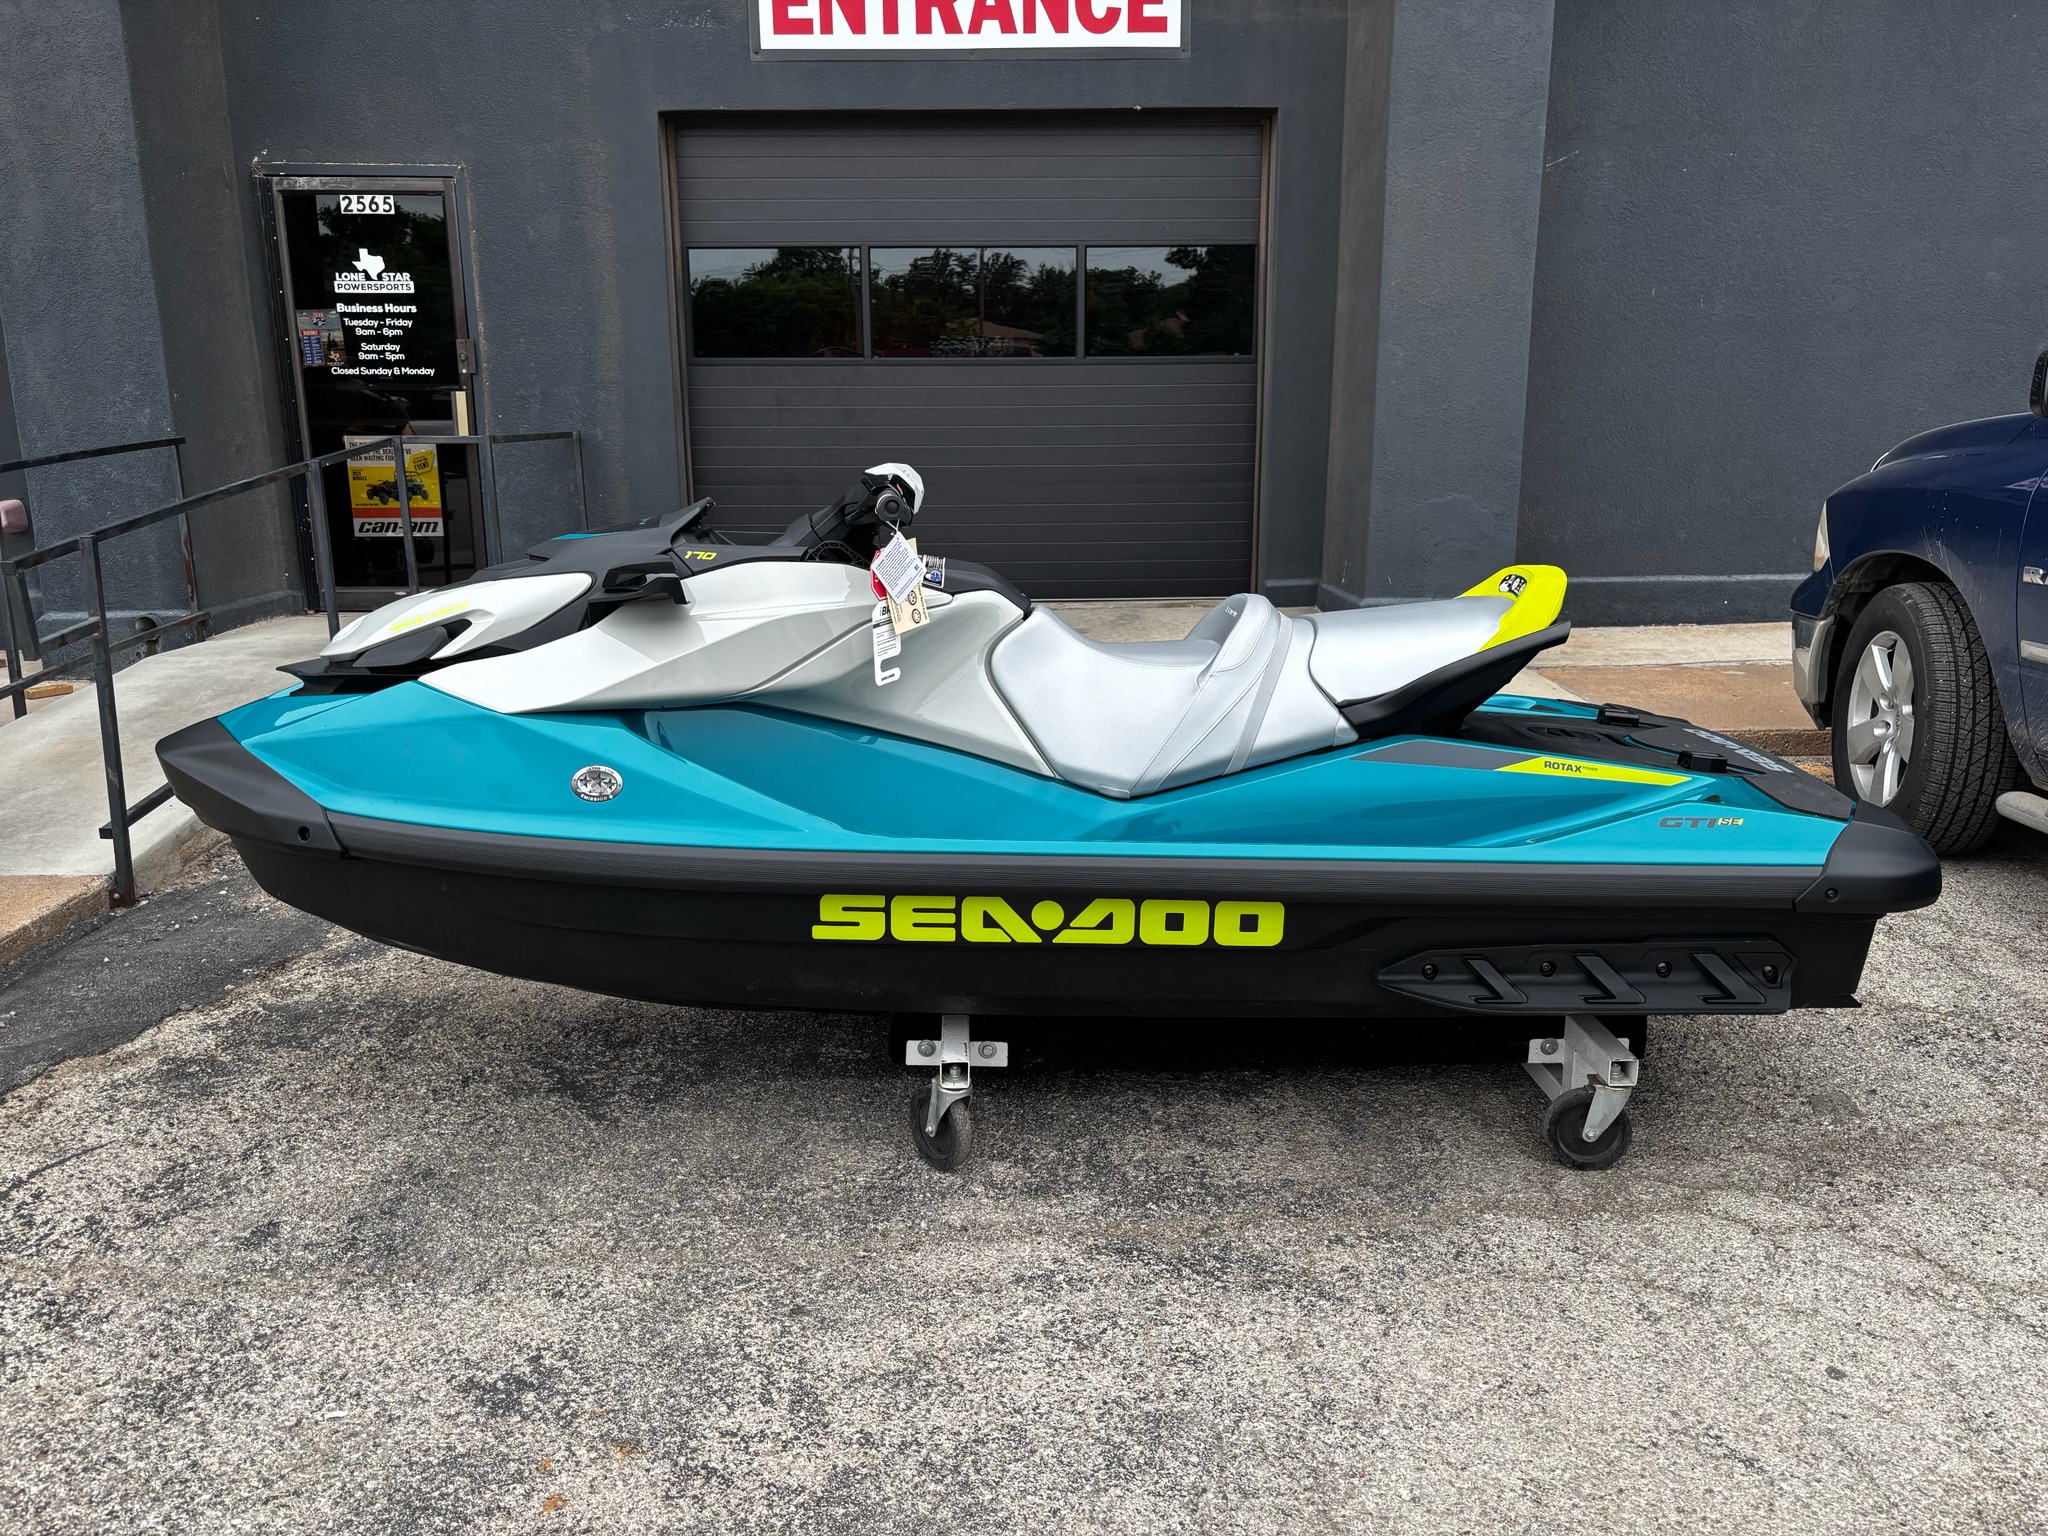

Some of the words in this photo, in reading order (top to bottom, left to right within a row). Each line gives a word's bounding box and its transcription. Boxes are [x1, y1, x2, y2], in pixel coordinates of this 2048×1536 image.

[341, 195, 393, 213] 2565
[335, 271, 367, 281] LONE
[381, 271, 412, 281] STAR
[336, 283, 412, 291] POWERSPORTS
[336, 302, 384, 313] Business
[384, 302, 418, 313] Hours
[343, 317, 379, 328] Tuesday
[385, 317, 413, 328] Friday
[355, 327, 376, 336] 9am
[382, 327, 403, 338] 6pm
[360, 342, 401, 353] Saturday
[358, 352, 379, 360] 9am
[385, 352, 406, 362] 5pm
[331, 366, 360, 375] Closed
[360, 366, 393, 377] Sunday
[393, 366, 401, 375] &
[401, 366, 435, 377] Monday
[684, 550, 717, 560] 170
[1544, 760, 1582, 773] ROTAX
[1659, 817, 1718, 829] GTI
